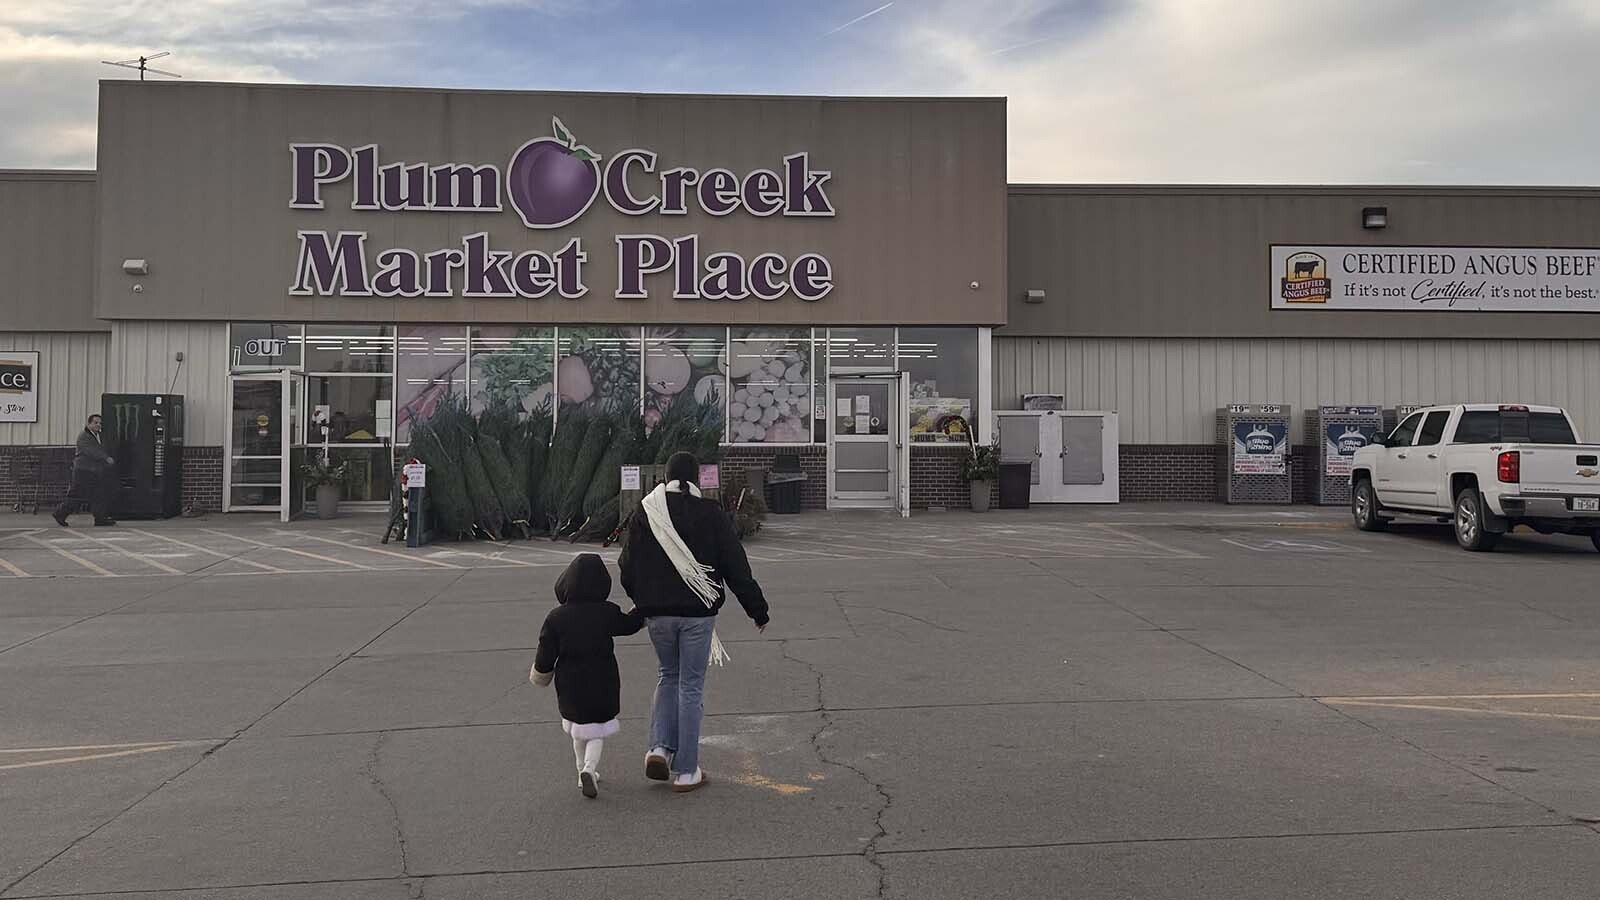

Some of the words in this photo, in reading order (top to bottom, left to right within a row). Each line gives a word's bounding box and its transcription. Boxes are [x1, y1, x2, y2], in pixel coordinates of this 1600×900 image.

[289, 143, 503, 212] Plum
[603, 148, 836, 218] Creek
[288, 230, 589, 298] Market
[614, 233, 834, 301] Place
[1342, 253, 1456, 274] CERTIFIED
[1464, 255, 1537, 275] ANGUS
[1283, 289, 1310, 298] ANGUS
[1285, 280, 1325, 290] CERTIFIED
[1344, 283, 1356, 296] If
[1359, 284, 1379, 297] it's
[1383, 286, 1406, 297] not
[1491, 285, 1510, 298] it's
[1513, 287, 1537, 298] not
[1540, 284, 1562, 298] the
[245, 339, 287, 356] OUT
